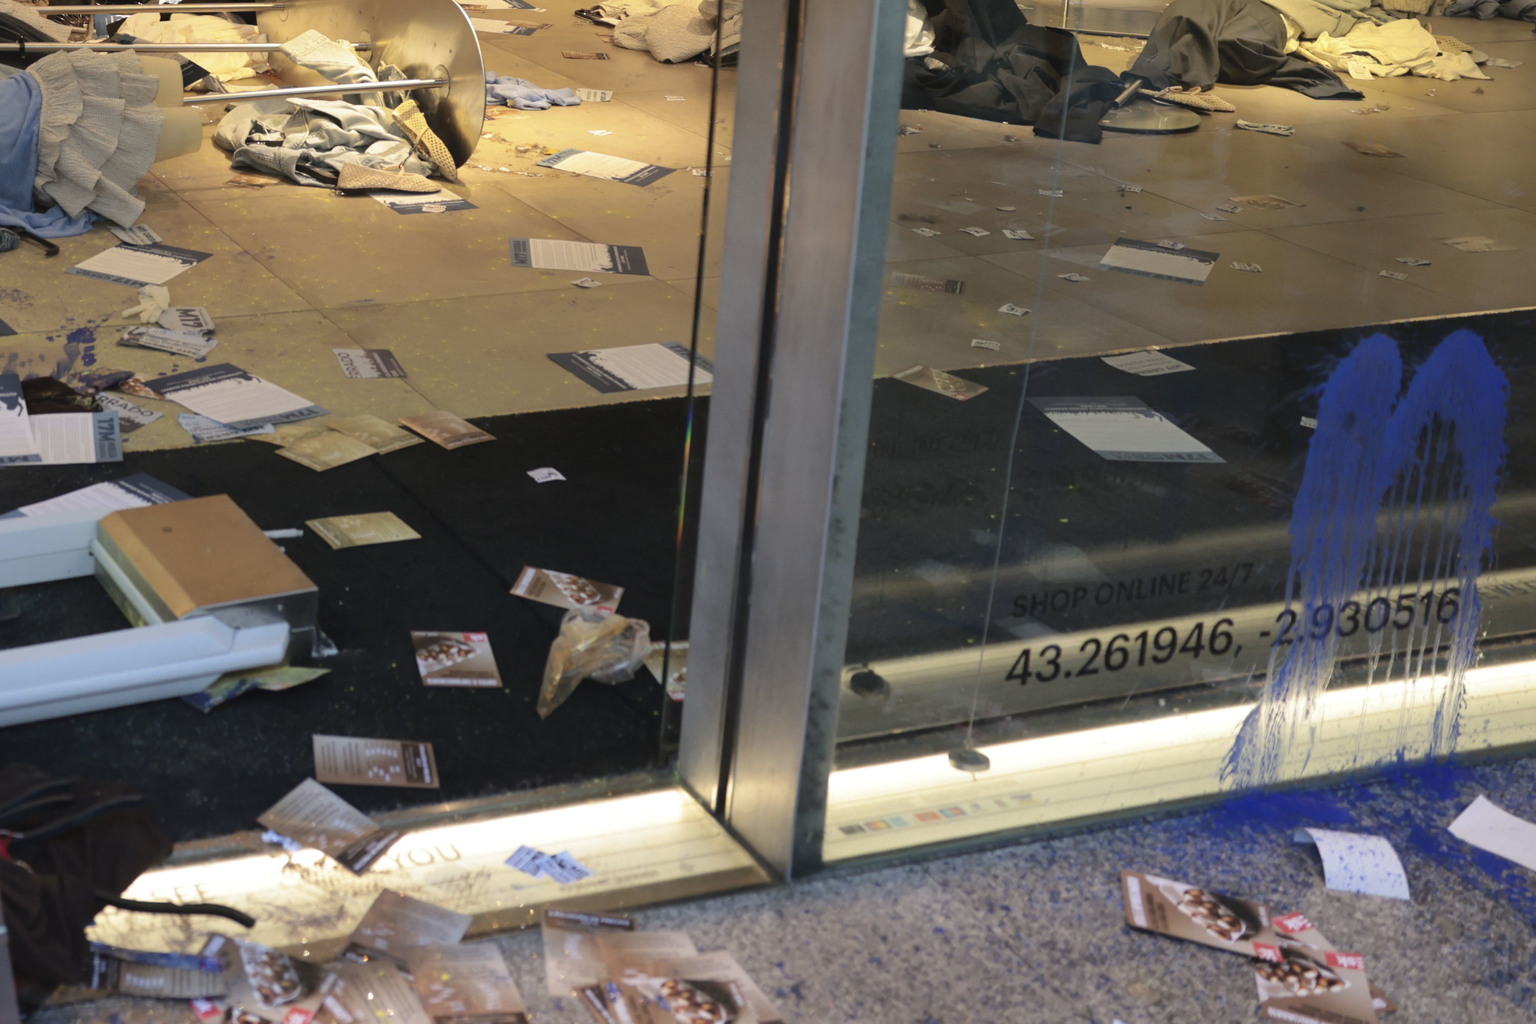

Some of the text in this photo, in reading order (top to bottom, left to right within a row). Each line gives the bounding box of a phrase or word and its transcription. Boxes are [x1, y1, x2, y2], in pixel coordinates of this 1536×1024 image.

[175, 308, 204, 328] M17
[1012, 562, 1255, 619] SHOP ONLINE 24/7
[1004, 587, 1461, 687] 43.261946, -2.930516
[390, 843, 462, 871] YOU
